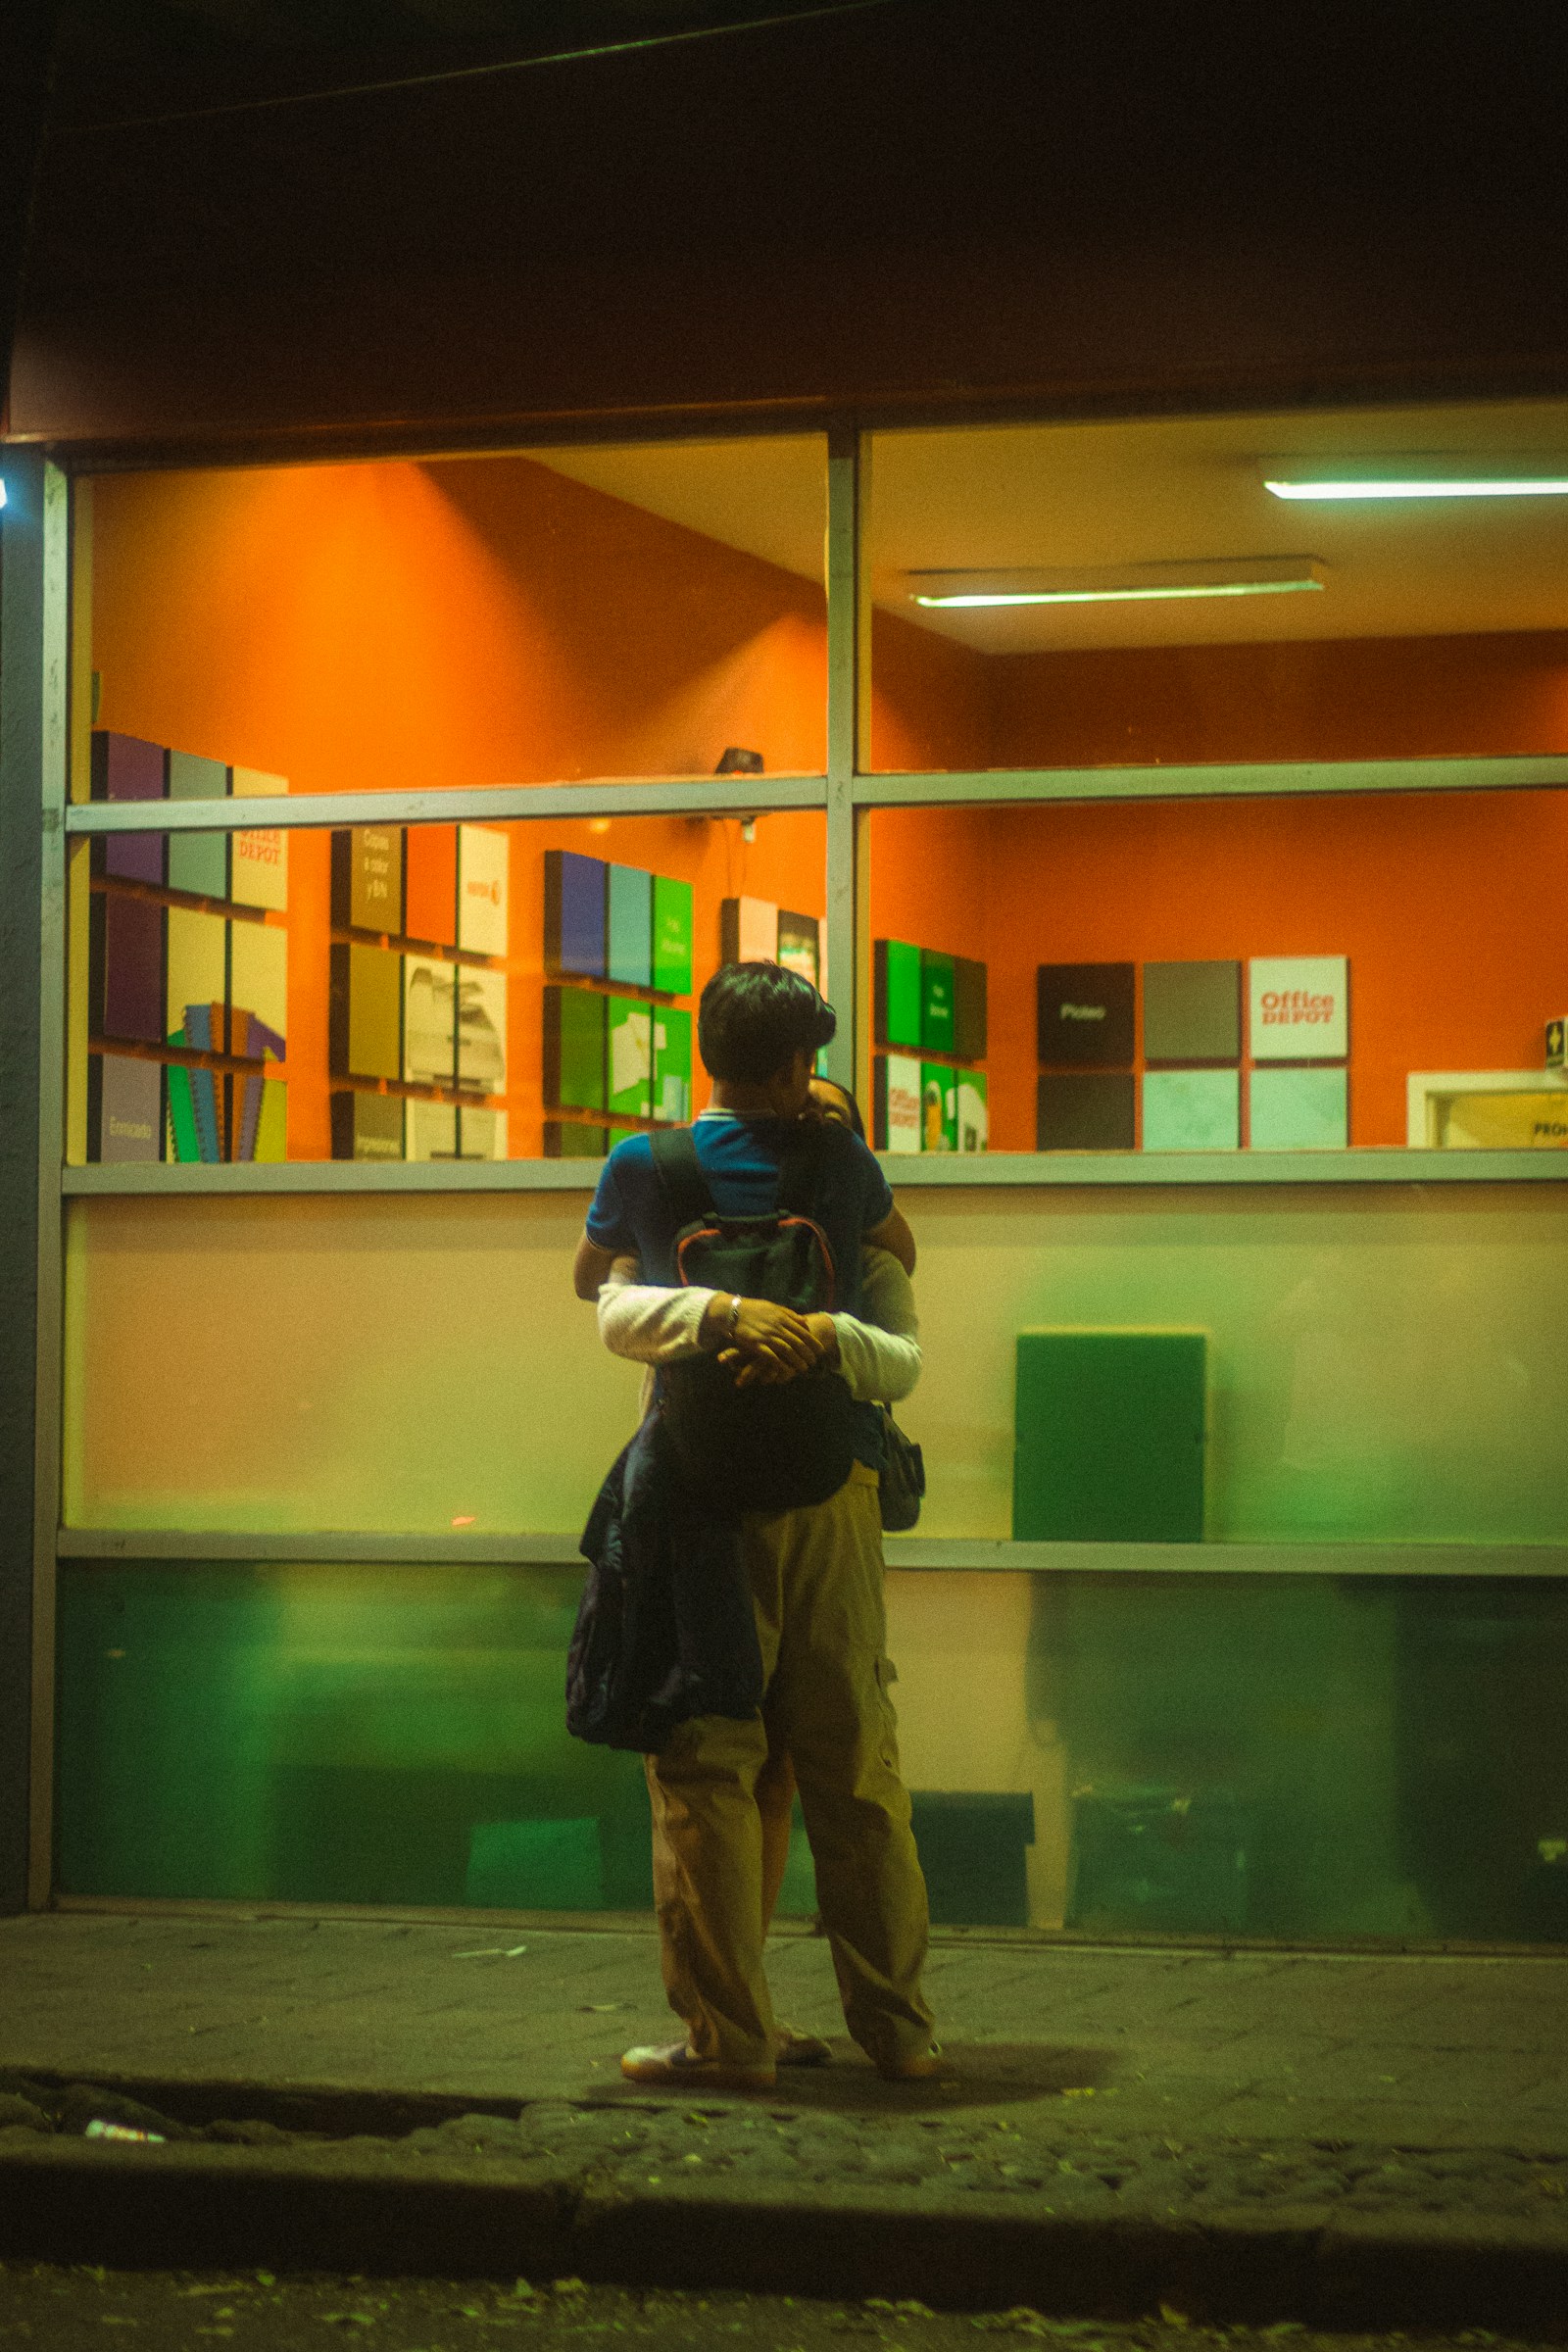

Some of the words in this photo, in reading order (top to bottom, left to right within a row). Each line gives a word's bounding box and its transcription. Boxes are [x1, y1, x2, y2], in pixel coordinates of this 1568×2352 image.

[239, 841, 281, 865] DEPOT
[1260, 988, 1334, 1010] Office
[1261, 1009, 1333, 1026] DEPOT
